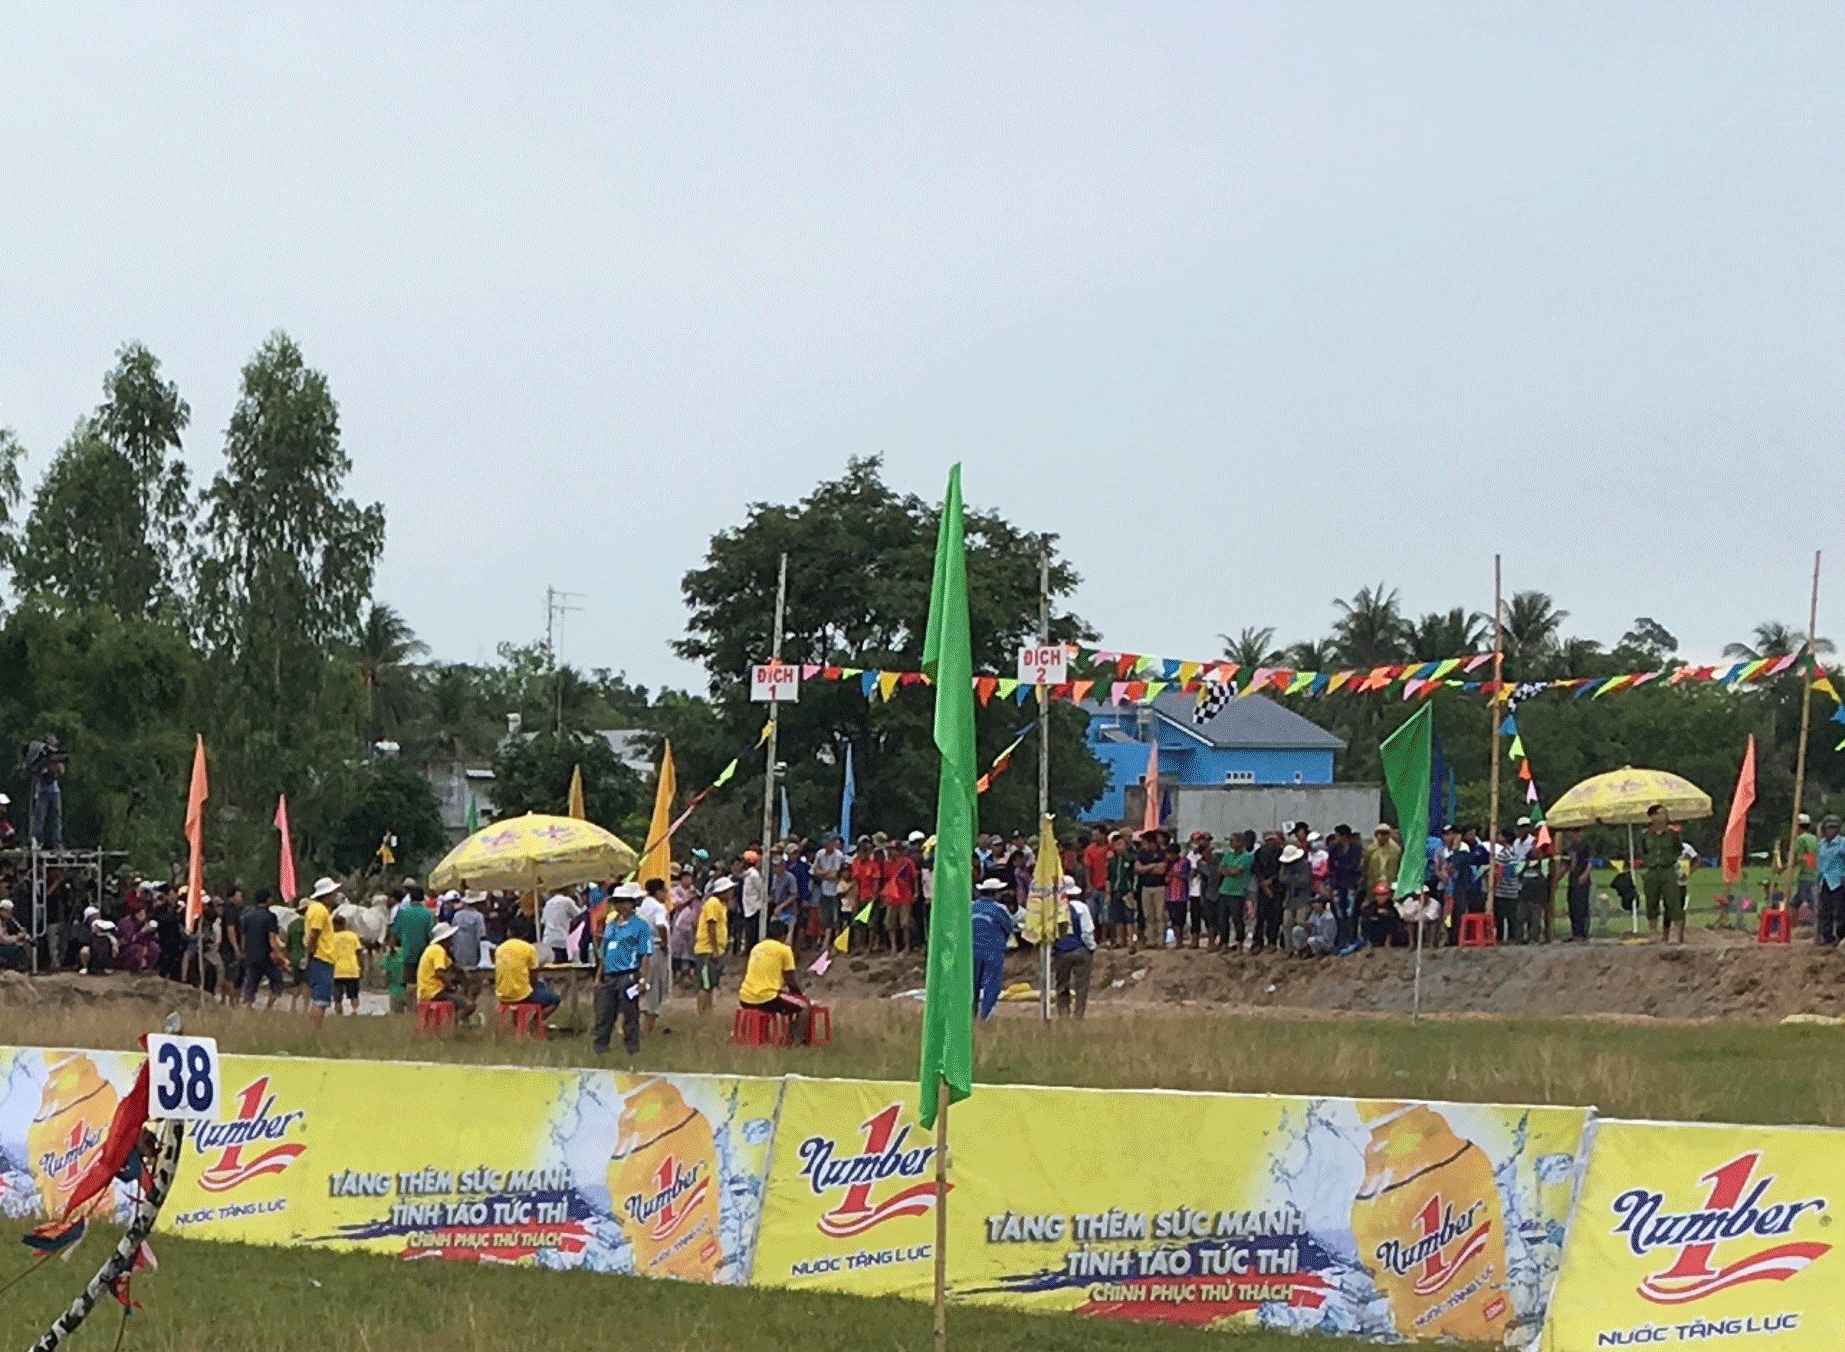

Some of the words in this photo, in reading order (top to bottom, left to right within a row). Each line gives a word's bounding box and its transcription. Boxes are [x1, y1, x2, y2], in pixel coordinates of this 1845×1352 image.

[768, 684, 776, 699] 1
[1036, 667, 1046, 682] 2
[157, 1042, 214, 1112] 38
[187, 1094, 304, 1154] Number
[206, 1076, 269, 1173] 1
[798, 1124, 948, 1194] Number
[624, 1159, 706, 1225] Number
[827, 1104, 901, 1216] 1
[1072, 1206, 1147, 1241] THÊM
[1376, 1199, 1483, 1276] Number
[1414, 1194, 1450, 1284] 1
[1612, 1176, 1826, 1255] Number
[1653, 1152, 1759, 1280] 1
[1597, 1323, 1669, 1347] NƯỚC
[1674, 1318, 1743, 1341] TĂNG
[1746, 1313, 1799, 1336] LỰC
